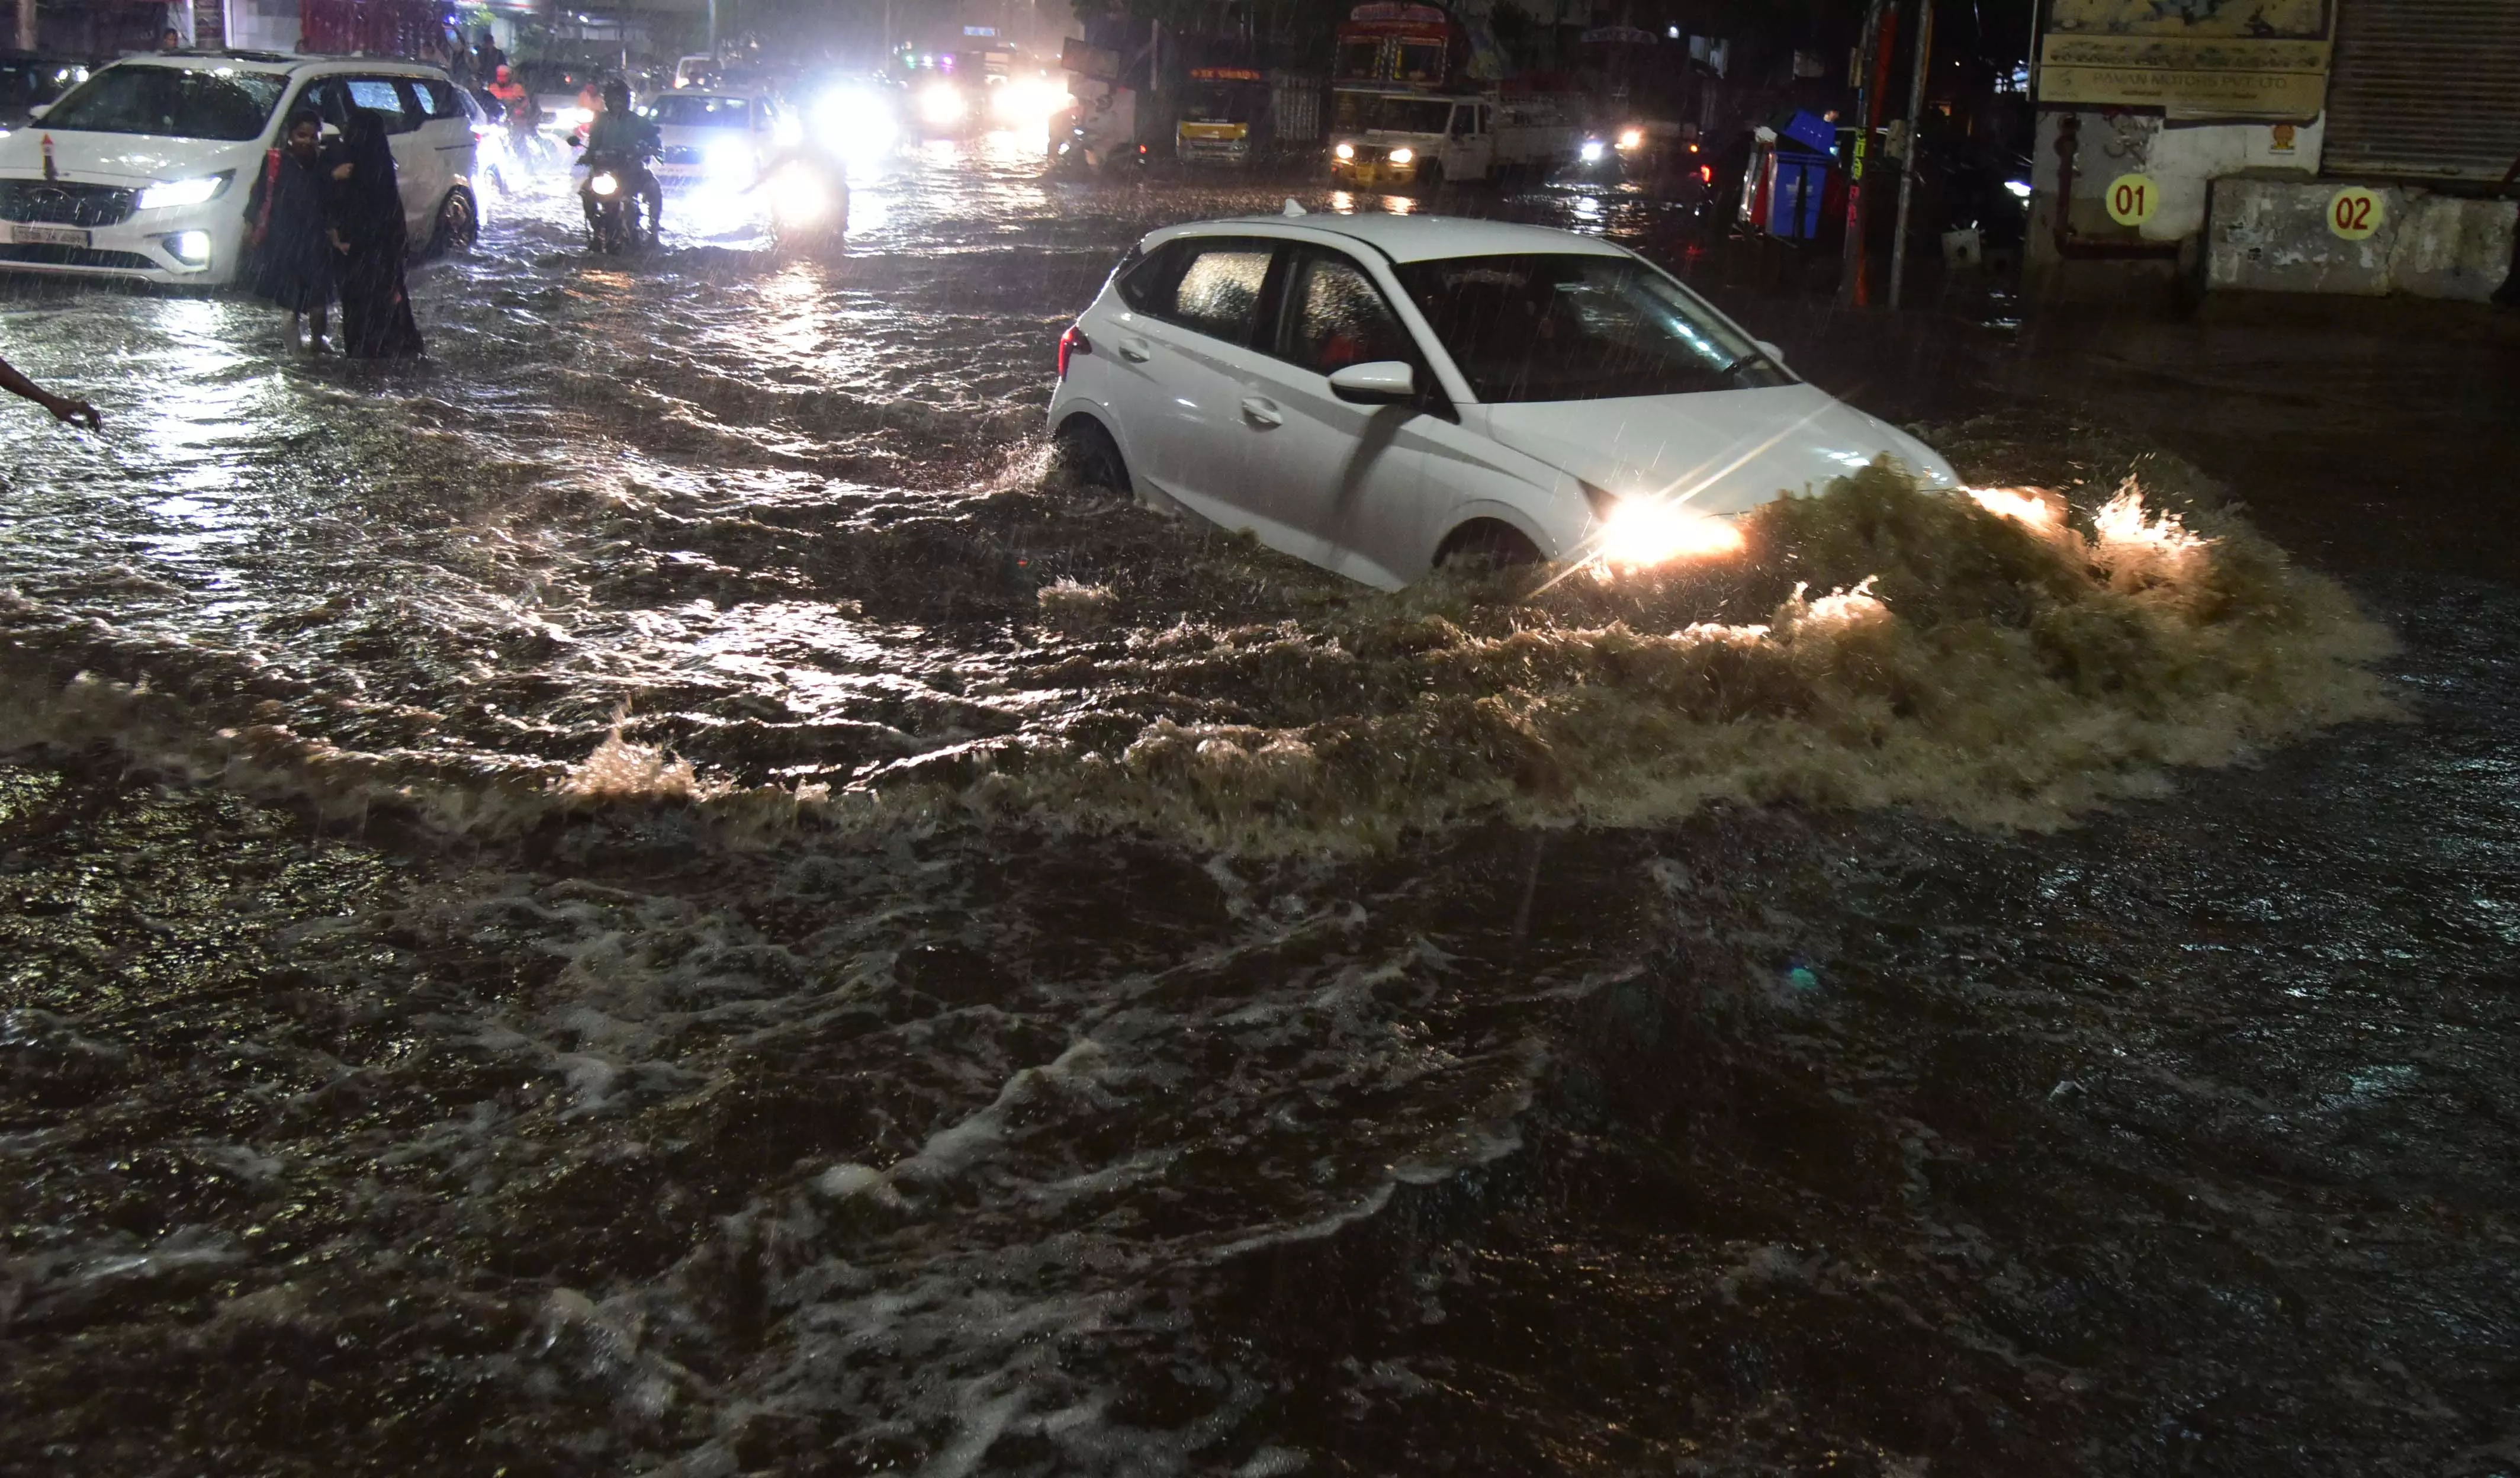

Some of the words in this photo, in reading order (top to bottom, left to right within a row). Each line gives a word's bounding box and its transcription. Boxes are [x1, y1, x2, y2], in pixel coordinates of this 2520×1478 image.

[2093, 72, 2146, 84] PAVAN
[2151, 74, 2218, 87] MOTORS
[2115, 185, 2144, 216] 01
[2336, 198, 2372, 230] 02
